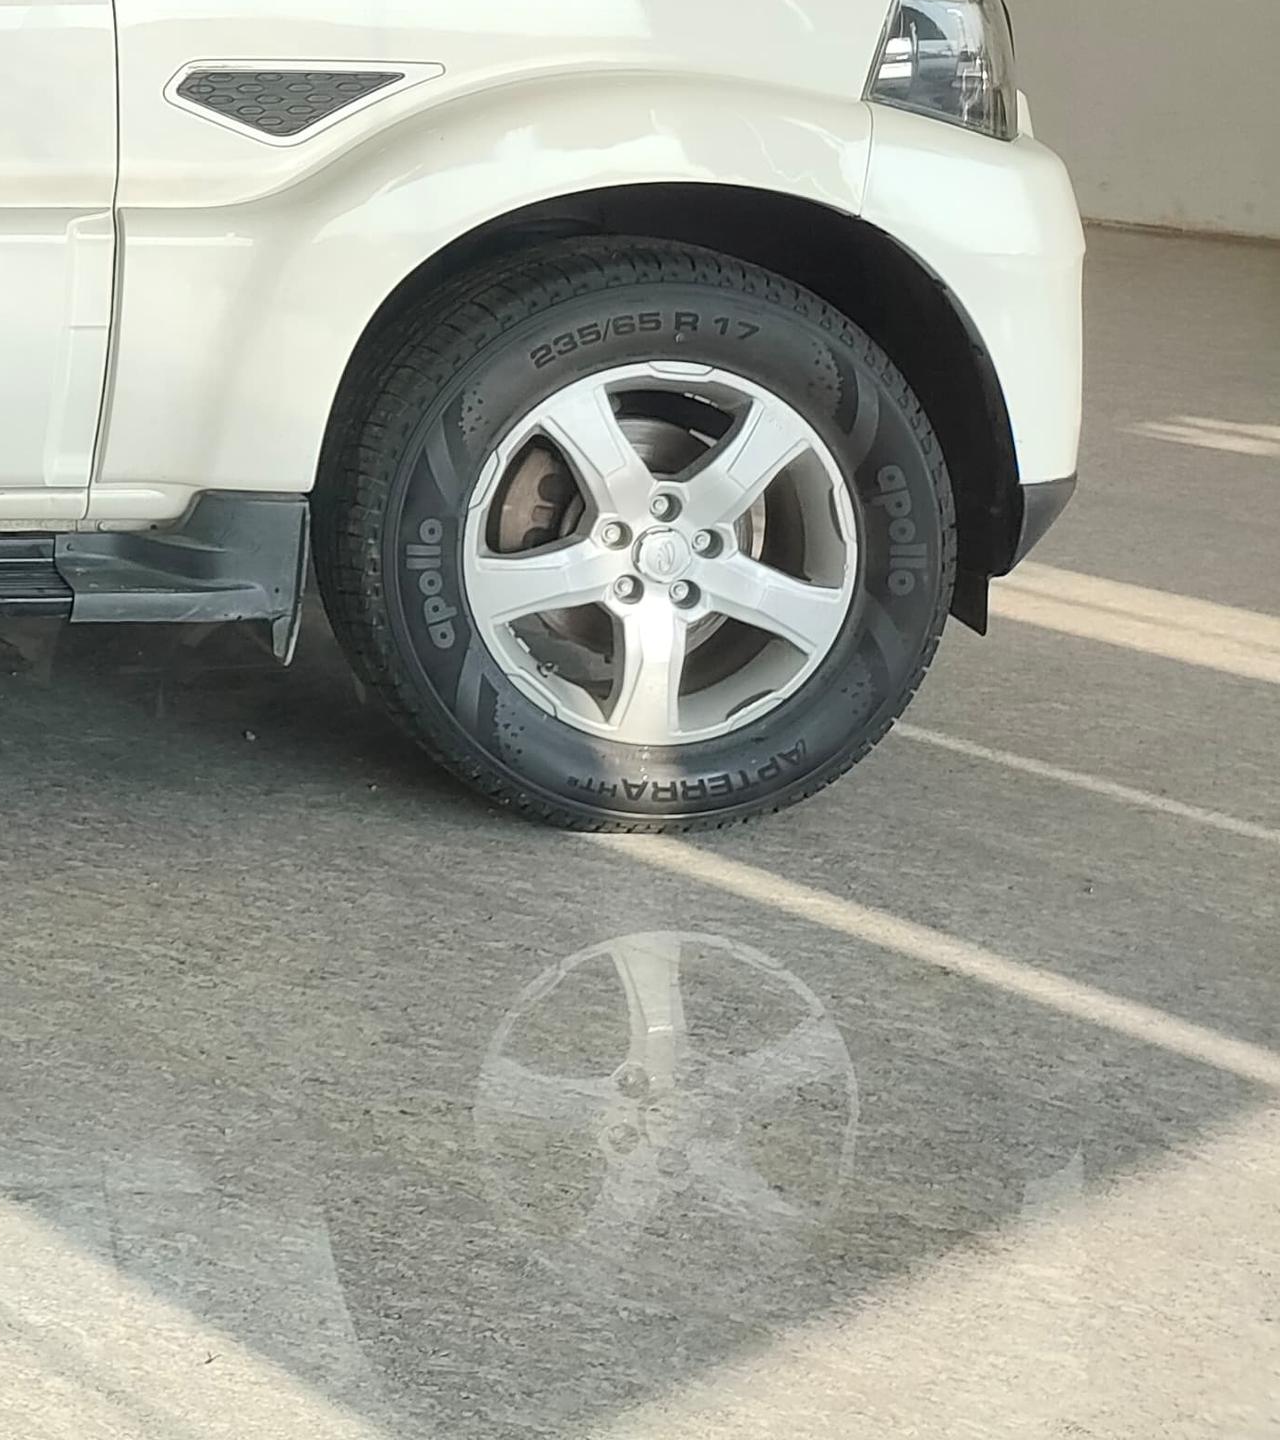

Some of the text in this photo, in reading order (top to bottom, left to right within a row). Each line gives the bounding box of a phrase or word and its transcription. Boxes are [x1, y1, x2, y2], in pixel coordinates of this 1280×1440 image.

[529, 311, 761, 369] 235/65 R 17
[405, 517, 459, 650] apollo
[869, 464, 928, 597] apollo
